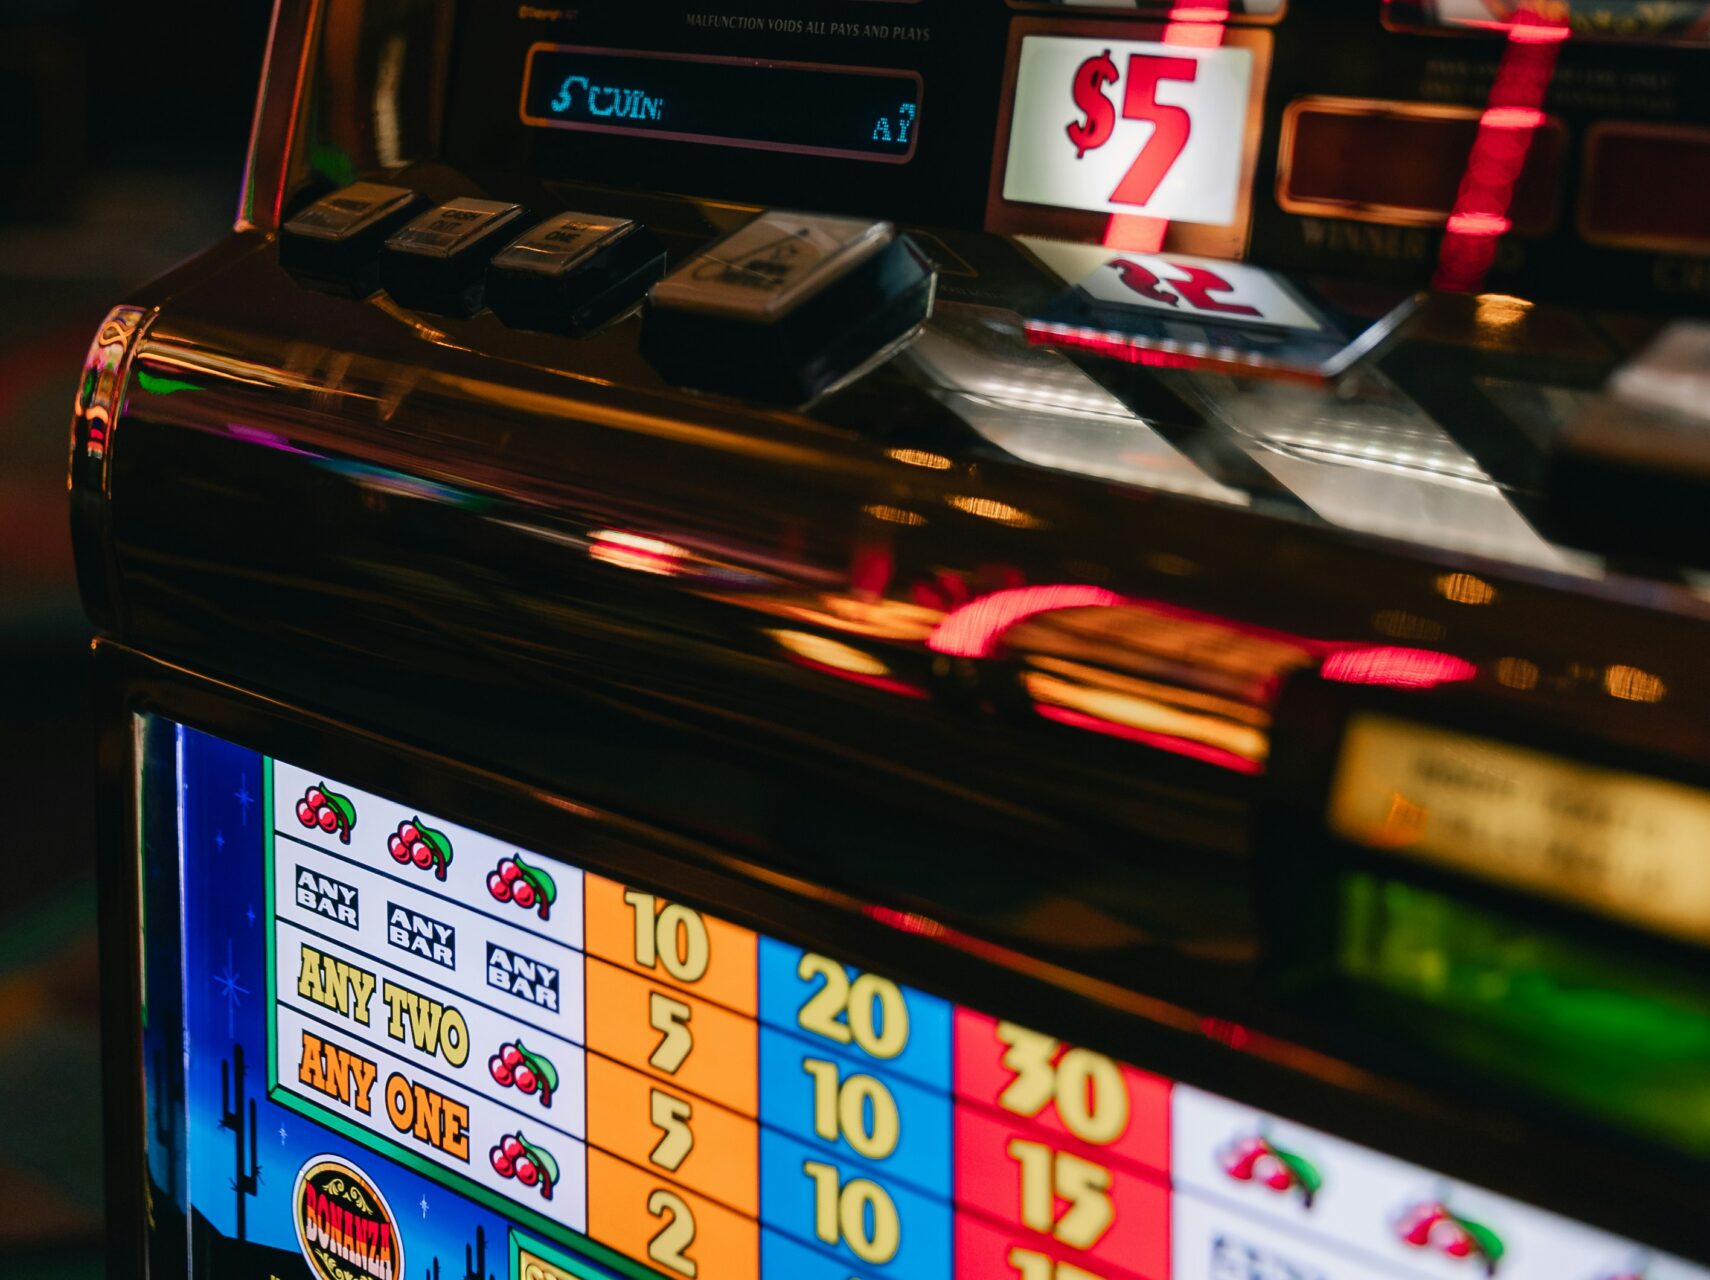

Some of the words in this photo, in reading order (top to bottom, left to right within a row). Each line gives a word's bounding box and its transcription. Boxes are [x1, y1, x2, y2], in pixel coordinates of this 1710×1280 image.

[686, 13, 764, 31] MALFUNCTION
[767, 18, 803, 33] VOIDS
[806, 21, 827, 35] ALL
[829, 22, 861, 37] PAYS
[863, 24, 889, 39] AND
[892, 26, 931, 42] PLAYS
[1065, 49, 1198, 207] $5
[297, 868, 357, 904] ANY
[391, 907, 453, 945] ANY
[490, 947, 557, 988] ANY
[297, 887, 357, 927] BAR
[390, 926, 454, 966] BAR
[489, 967, 558, 1011] BAR
[624, 890, 710, 983] 10
[298, 942, 377, 1028] ANY
[383, 977, 470, 1068] TWO
[648, 990, 693, 1076] 5
[797, 952, 910, 1060] 20
[298, 1028, 378, 1117] ANY
[385, 1071, 470, 1165] ONE
[648, 1087, 694, 1174] 5
[803, 1057, 900, 1161] 10
[996, 1020, 1131, 1146] 30
[305, 1179, 393, 1280] BONANZA
[647, 1188, 698, 1280] 2
[803, 1160, 900, 1265] 10
[1007, 1137, 1118, 1251] 15
